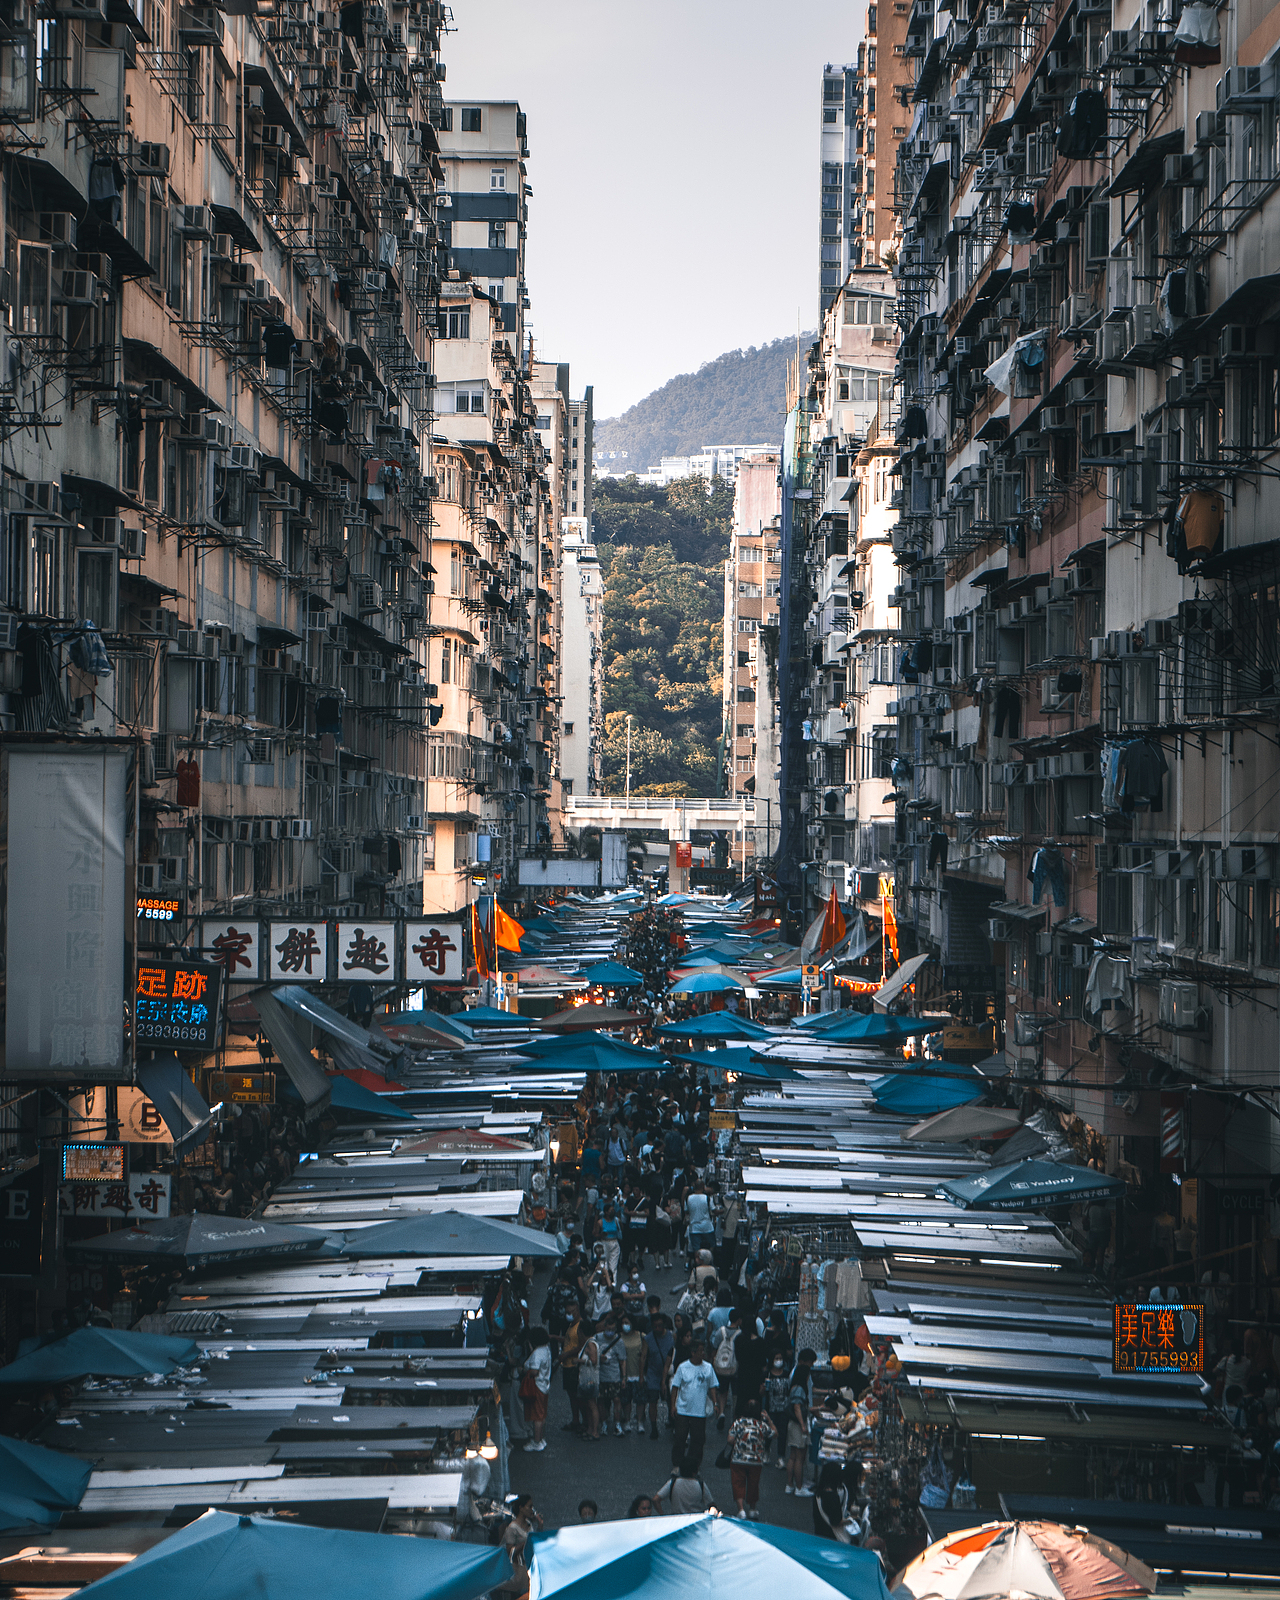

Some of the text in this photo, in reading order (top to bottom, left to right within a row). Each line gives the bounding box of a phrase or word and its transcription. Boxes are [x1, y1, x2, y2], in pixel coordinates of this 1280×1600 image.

[136, 967, 208, 1000] 足跡
[136, 1023, 207, 1041] 23938698
[141, 1103, 161, 1127] B
[1030, 1175, 1075, 1188] Yedpay
[1222, 1194, 1262, 1209] CYCLE
[1121, 1308, 1175, 1349] 美足樂
[1120, 1351, 1199, 1367] 91755993
